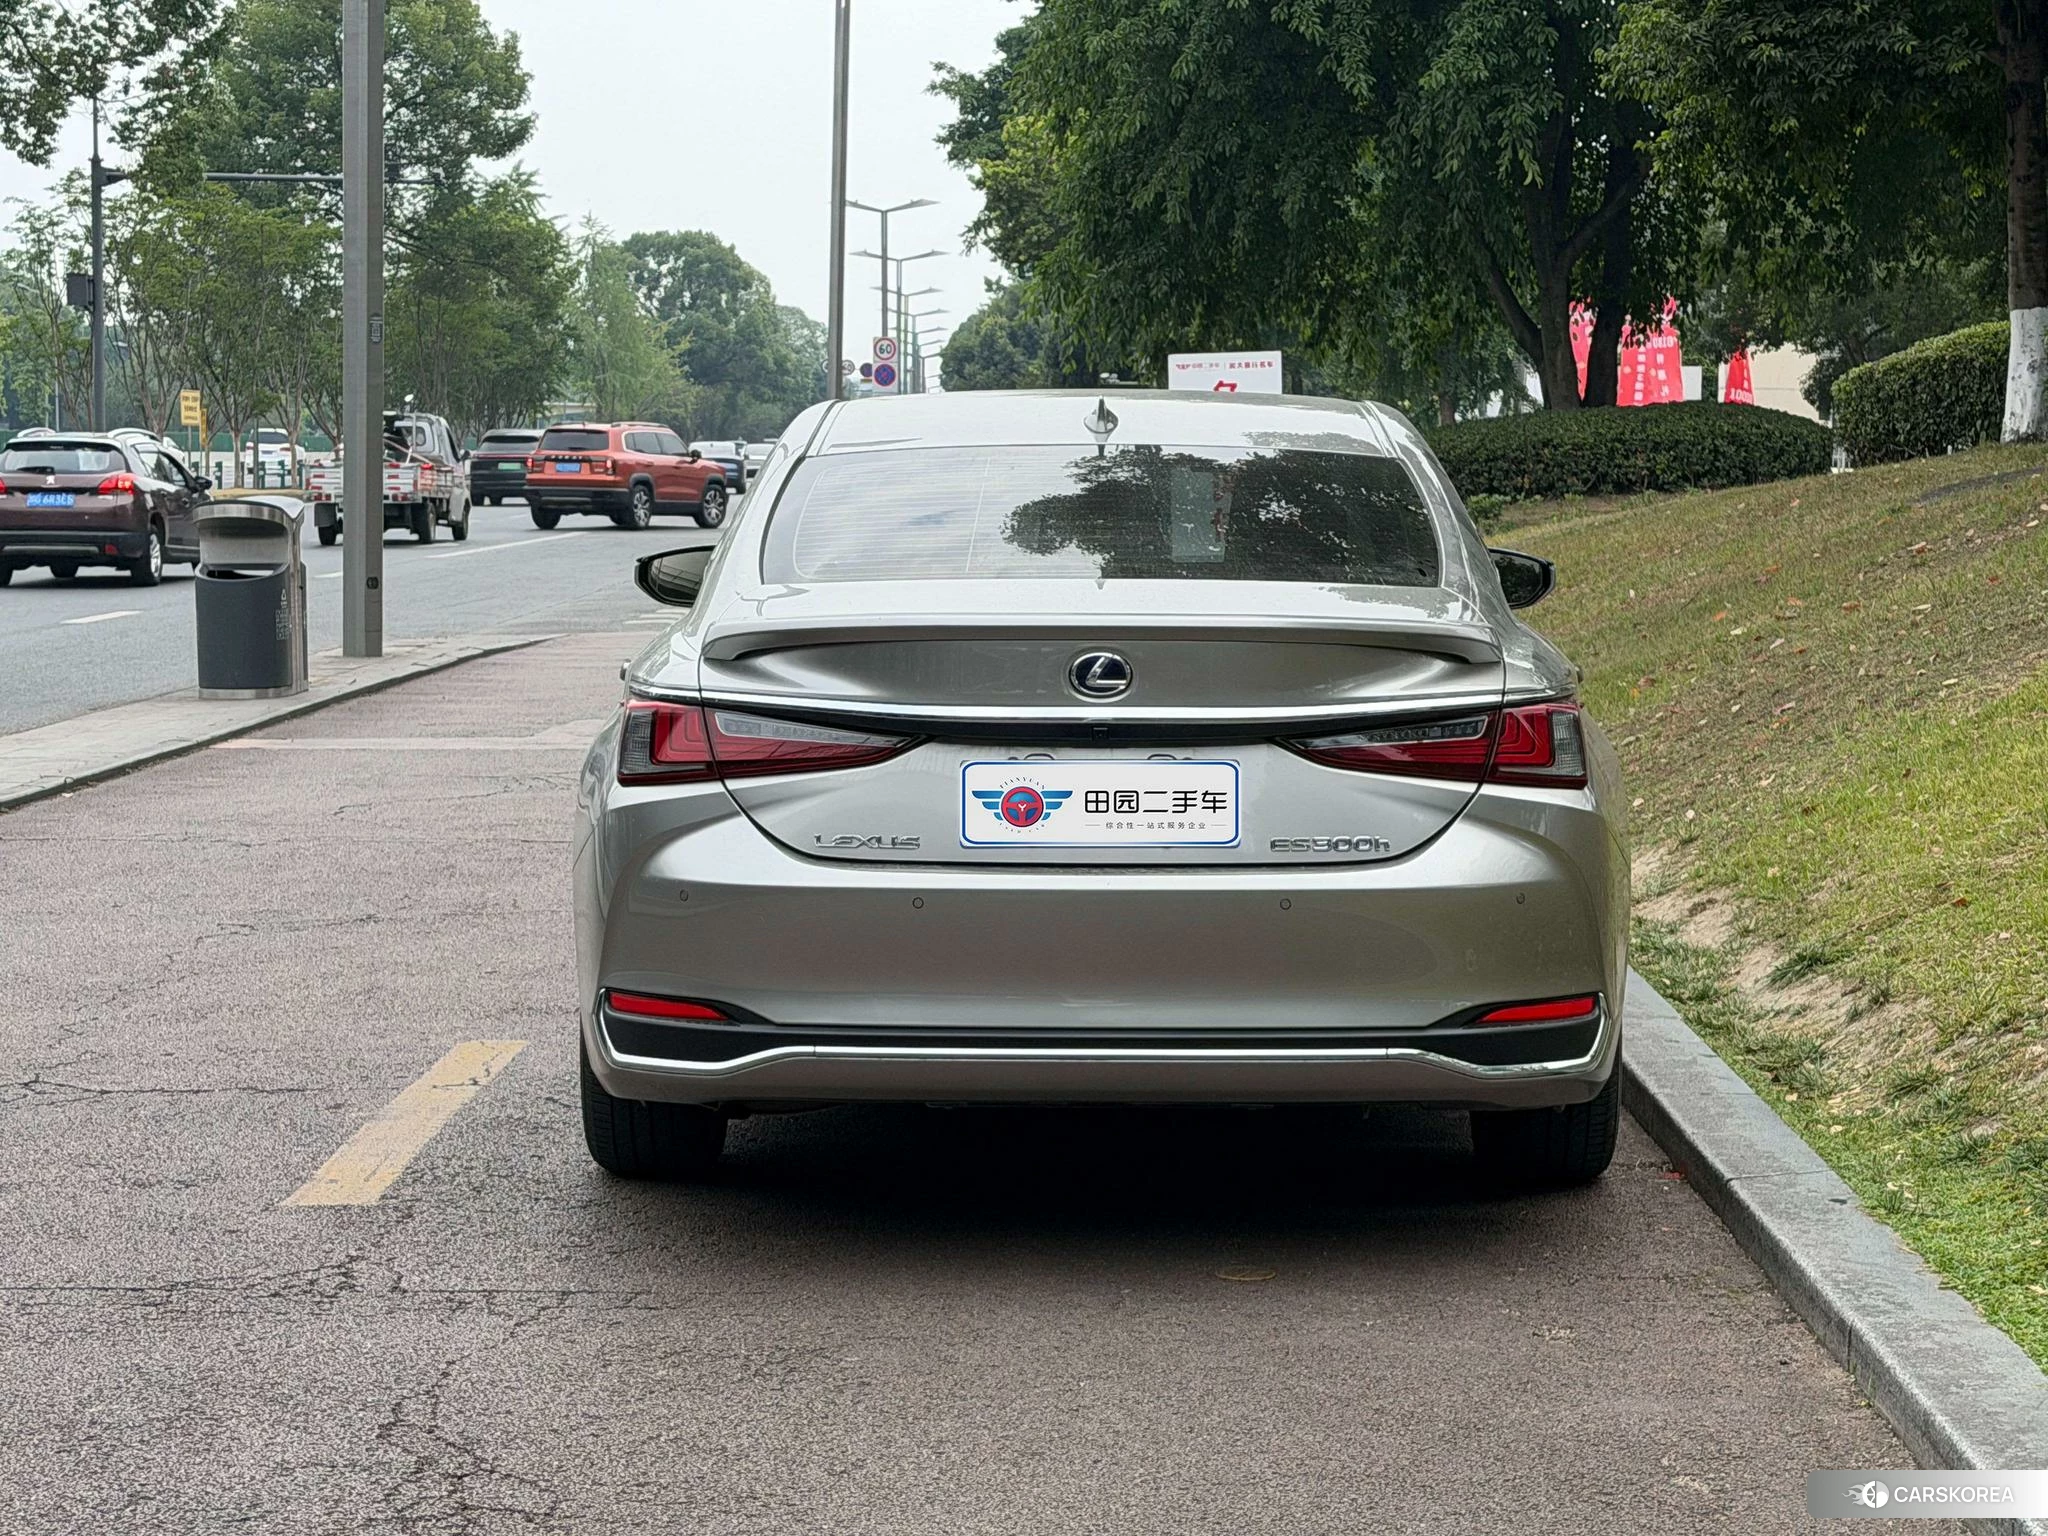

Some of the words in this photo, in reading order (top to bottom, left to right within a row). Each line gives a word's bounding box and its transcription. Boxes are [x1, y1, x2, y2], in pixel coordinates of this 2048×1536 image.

[879, 343, 892, 354] 60
[1084, 790, 1228, 814] 田园二手车
[1105, 821, 1207, 830] 综合性一站式服务企业
[814, 833, 921, 850] LEXUS
[1270, 836, 1390, 852] ES300h
